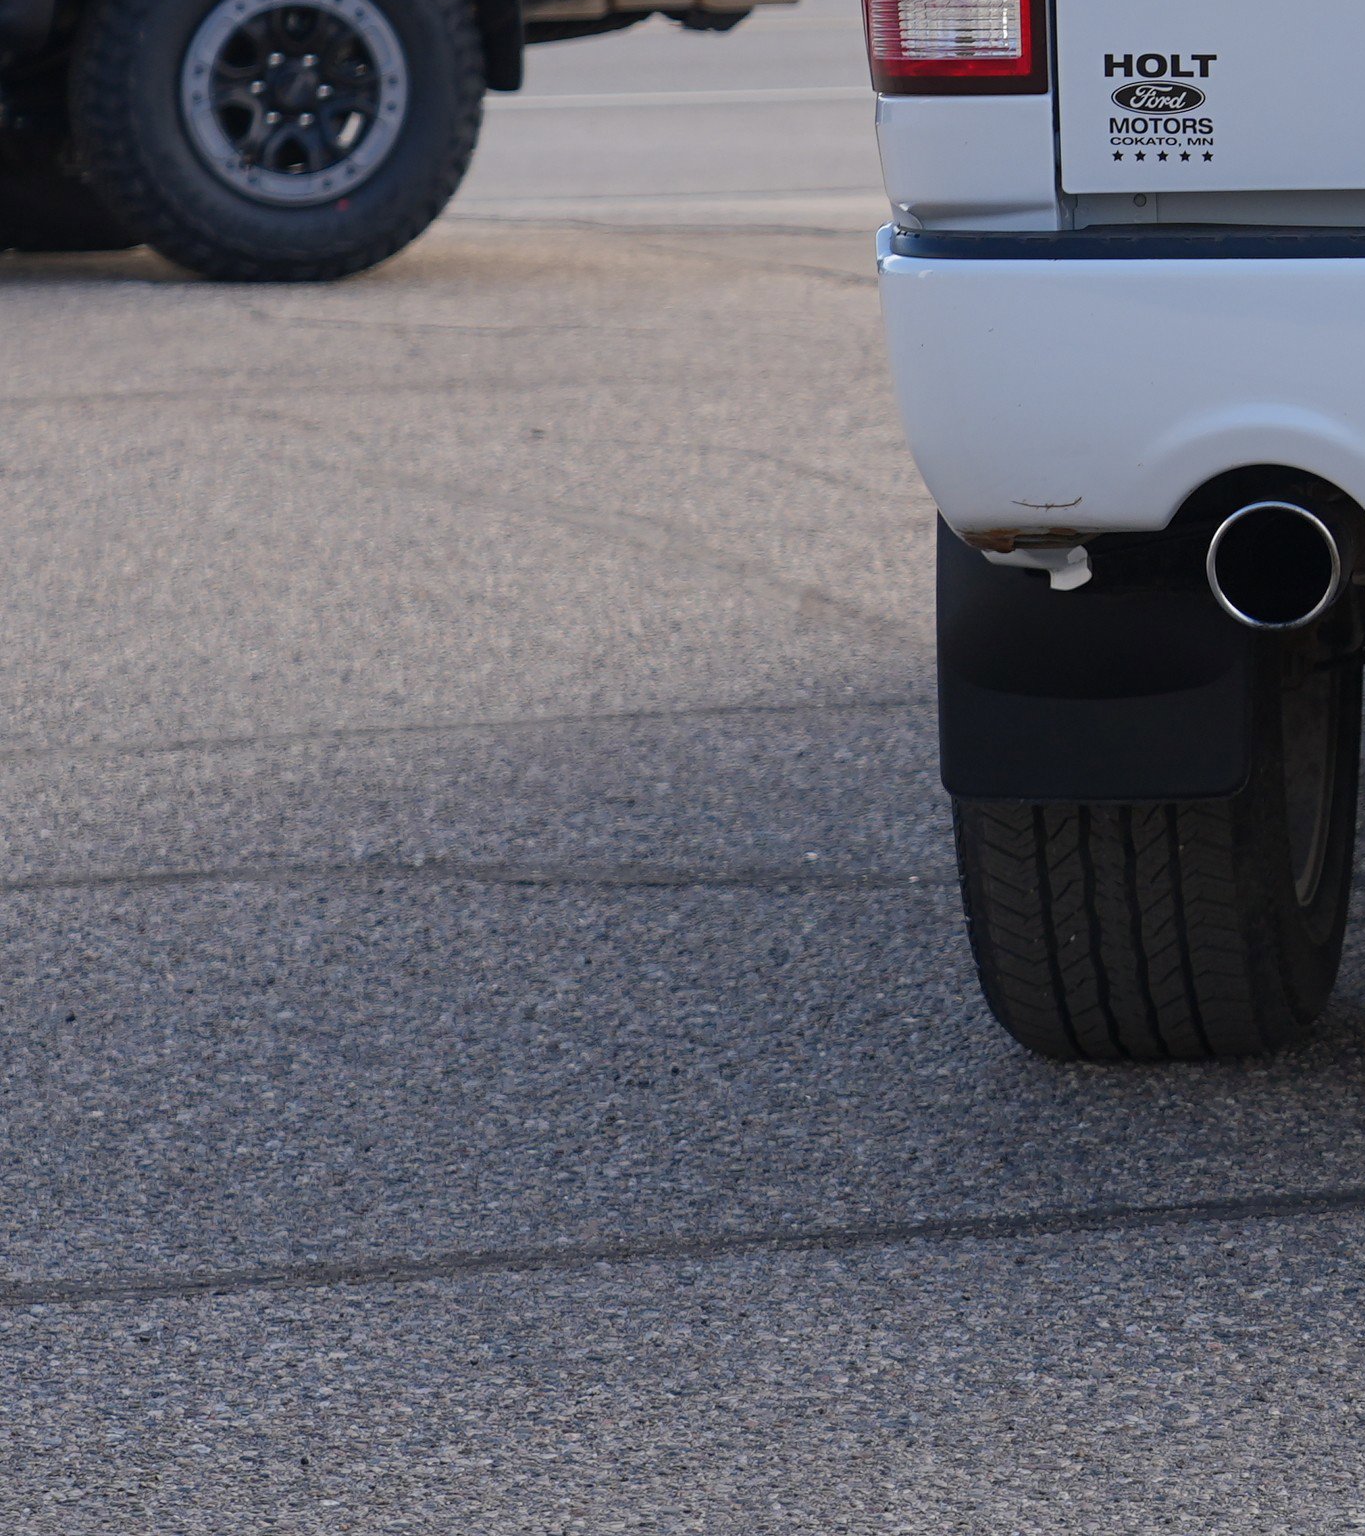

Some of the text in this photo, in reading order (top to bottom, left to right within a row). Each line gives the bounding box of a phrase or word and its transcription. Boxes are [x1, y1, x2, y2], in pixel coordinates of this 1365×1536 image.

[1104, 53, 1217, 78] HOLT
[1129, 85, 1187, 109] Ford
[1109, 117, 1213, 134] MOTORS
[1110, 137, 1214, 147] COKATO, MN
